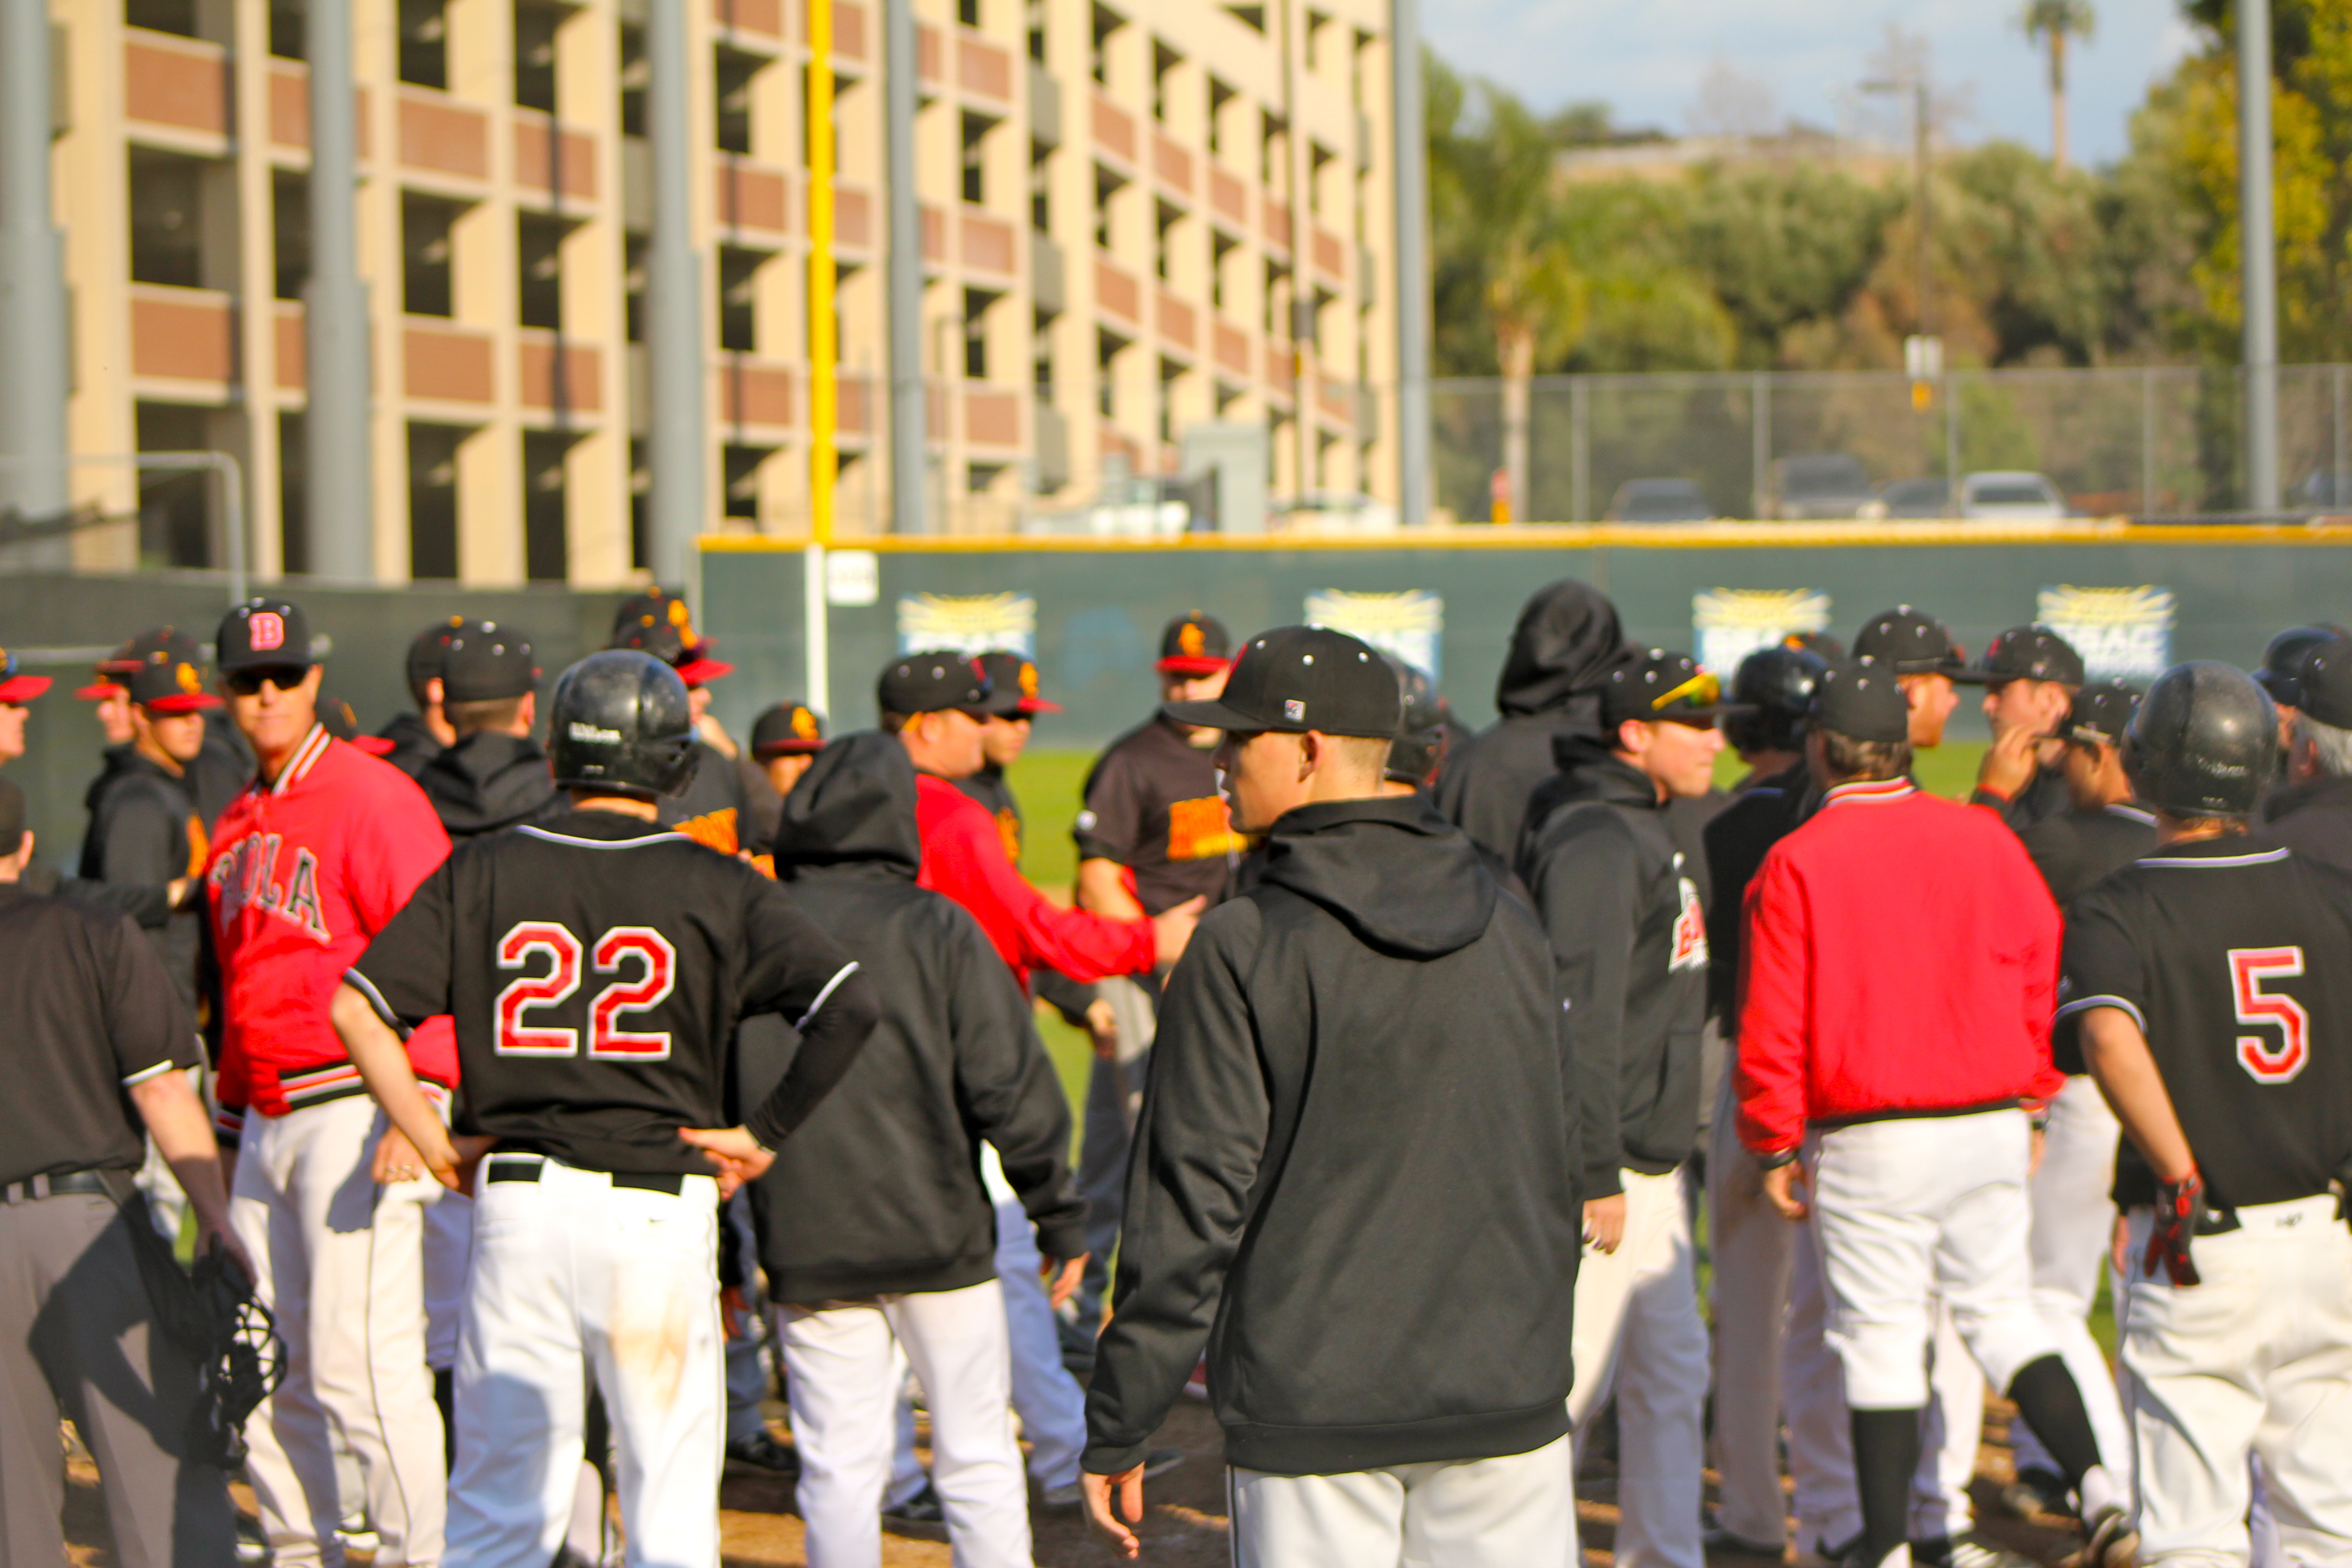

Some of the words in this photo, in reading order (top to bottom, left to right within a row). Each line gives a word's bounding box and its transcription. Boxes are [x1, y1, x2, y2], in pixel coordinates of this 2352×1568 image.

[249, 612, 285, 652] B
[494, 921, 676, 1063] 22
[2227, 945, 2310, 1085] 5
